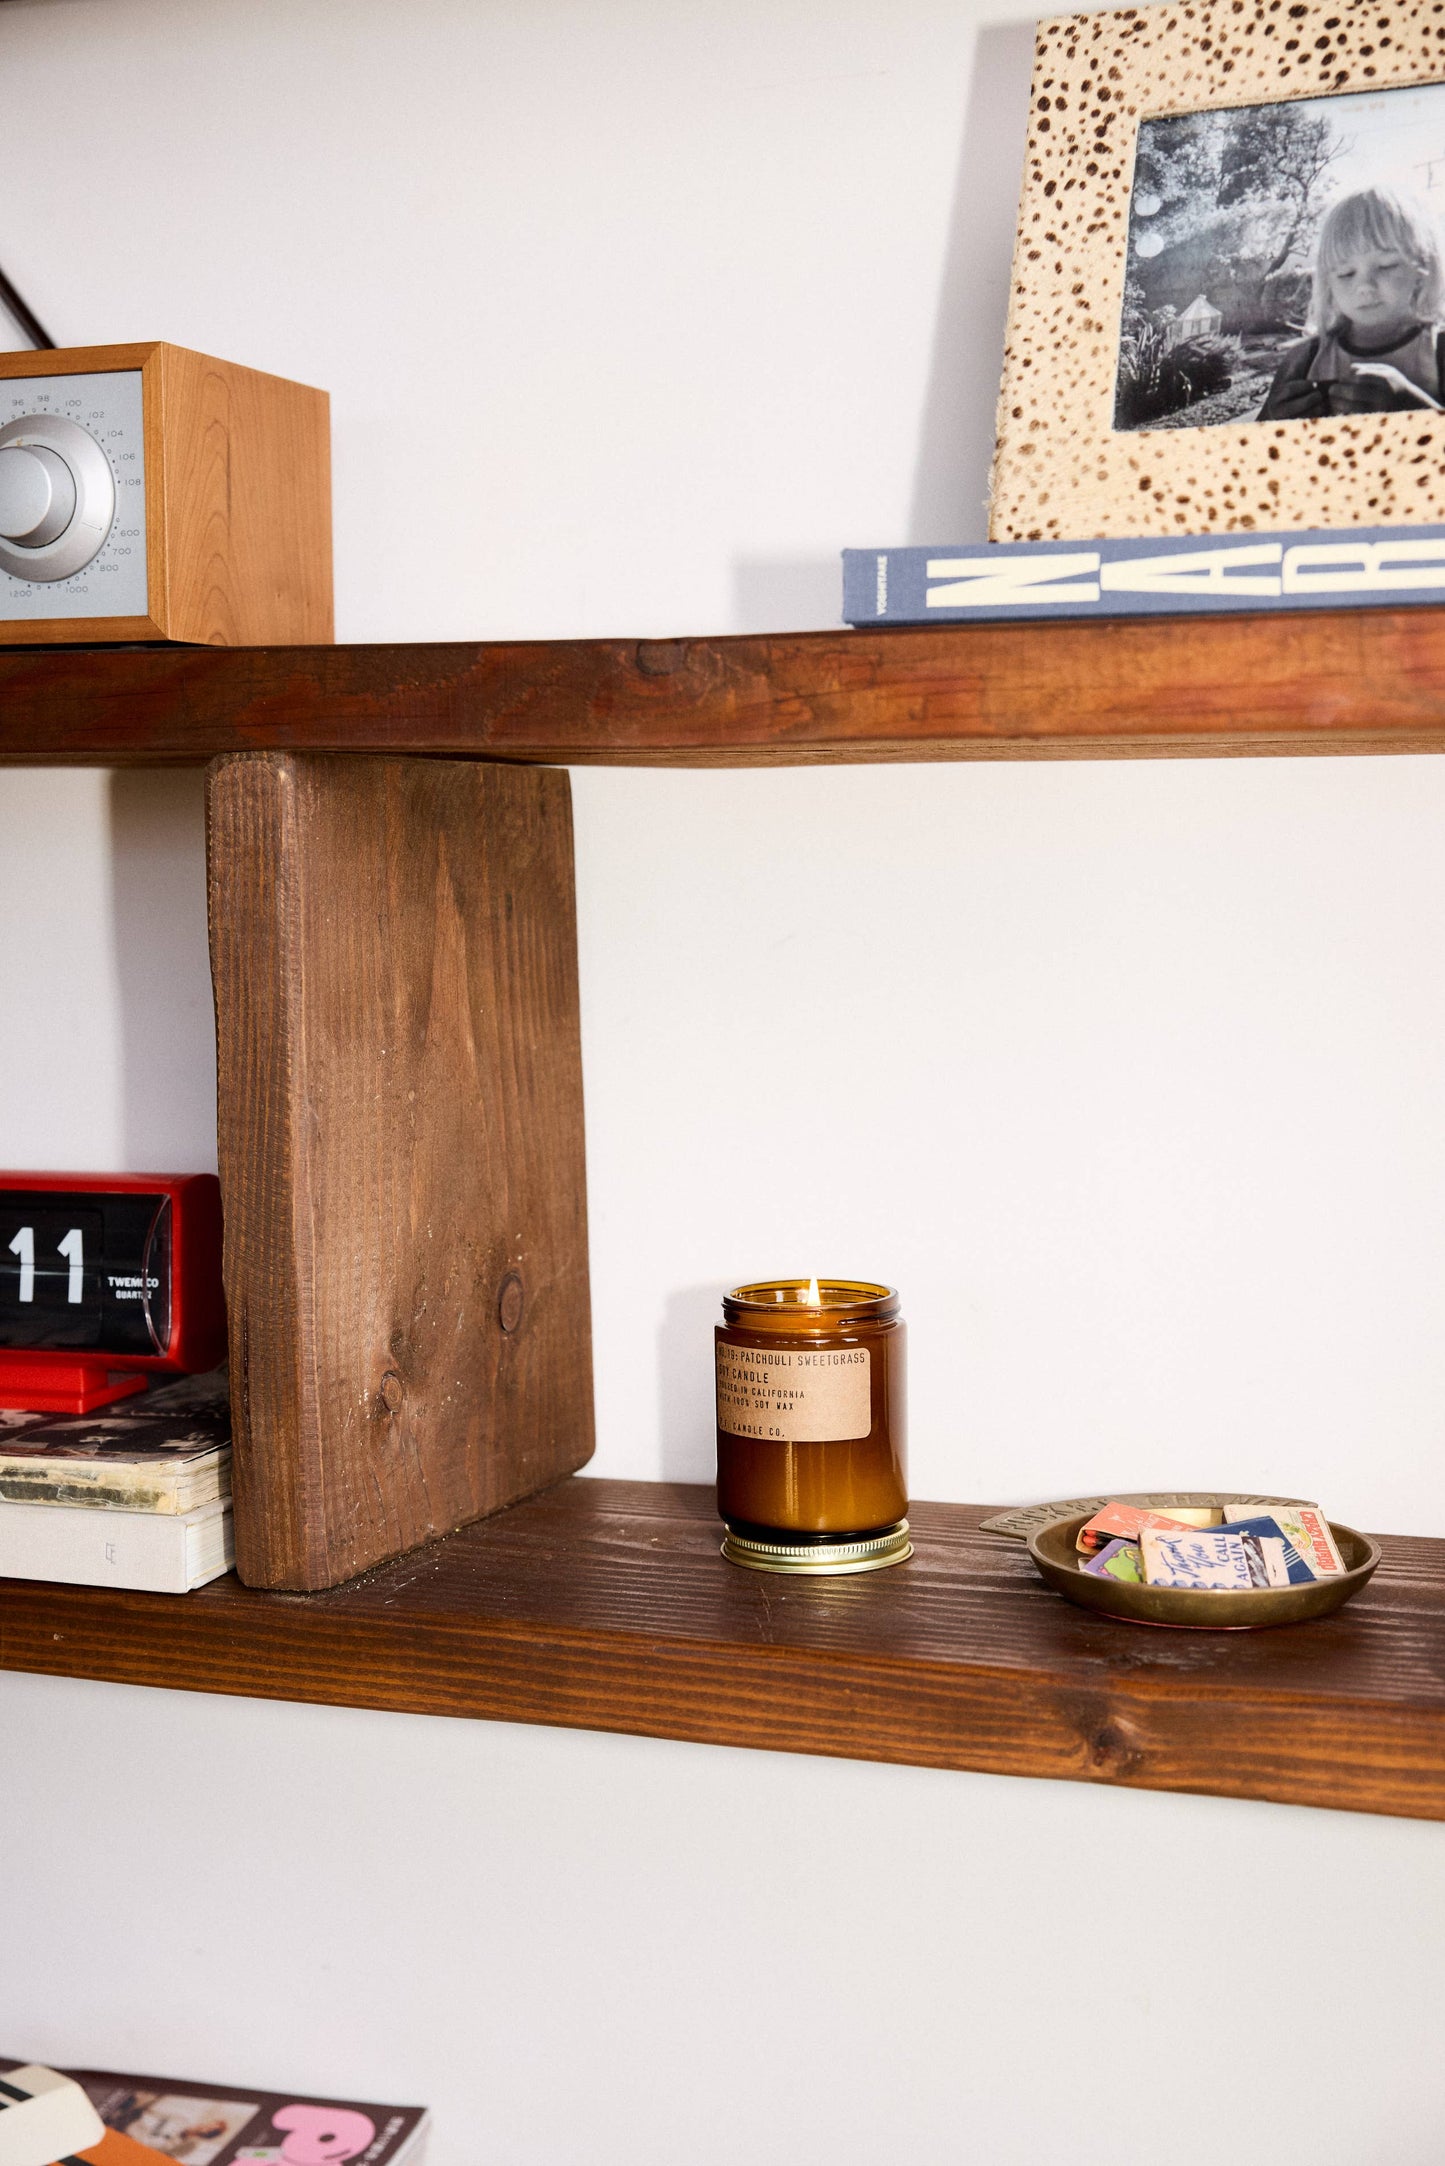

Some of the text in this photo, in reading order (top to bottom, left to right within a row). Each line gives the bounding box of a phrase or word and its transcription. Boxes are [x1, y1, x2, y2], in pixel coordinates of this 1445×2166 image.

[37, 394, 50, 402] 98
[65, 399, 82, 407] 100
[89, 411, 105, 419] 102
[107, 429, 124, 437] 104
[120, 529, 140, 537] 600
[99, 564, 119, 572] 800
[65, 585, 88, 593] 1000
[9, 590, 32, 598] 1200
[740, 1352, 792, 1366] PATCHOULI
[797, 1353, 865, 1367] SWEETGRASS
[718, 1364, 769, 1384] SOY CANDLE
[740, 1386, 748, 1394] IN
[751, 1388, 805, 1399] CALIFORNIA
[755, 1400, 770, 1409] SOY
[776, 1401, 794, 1410] WAX
[733, 1422, 763, 1435] CANDLE
[769, 1428, 785, 1437] CO.
[1214, 1536, 1230, 1563] CALL
[1155, 1535, 1200, 1579] Thank
[1229, 1541, 1250, 1582] AGAIN
